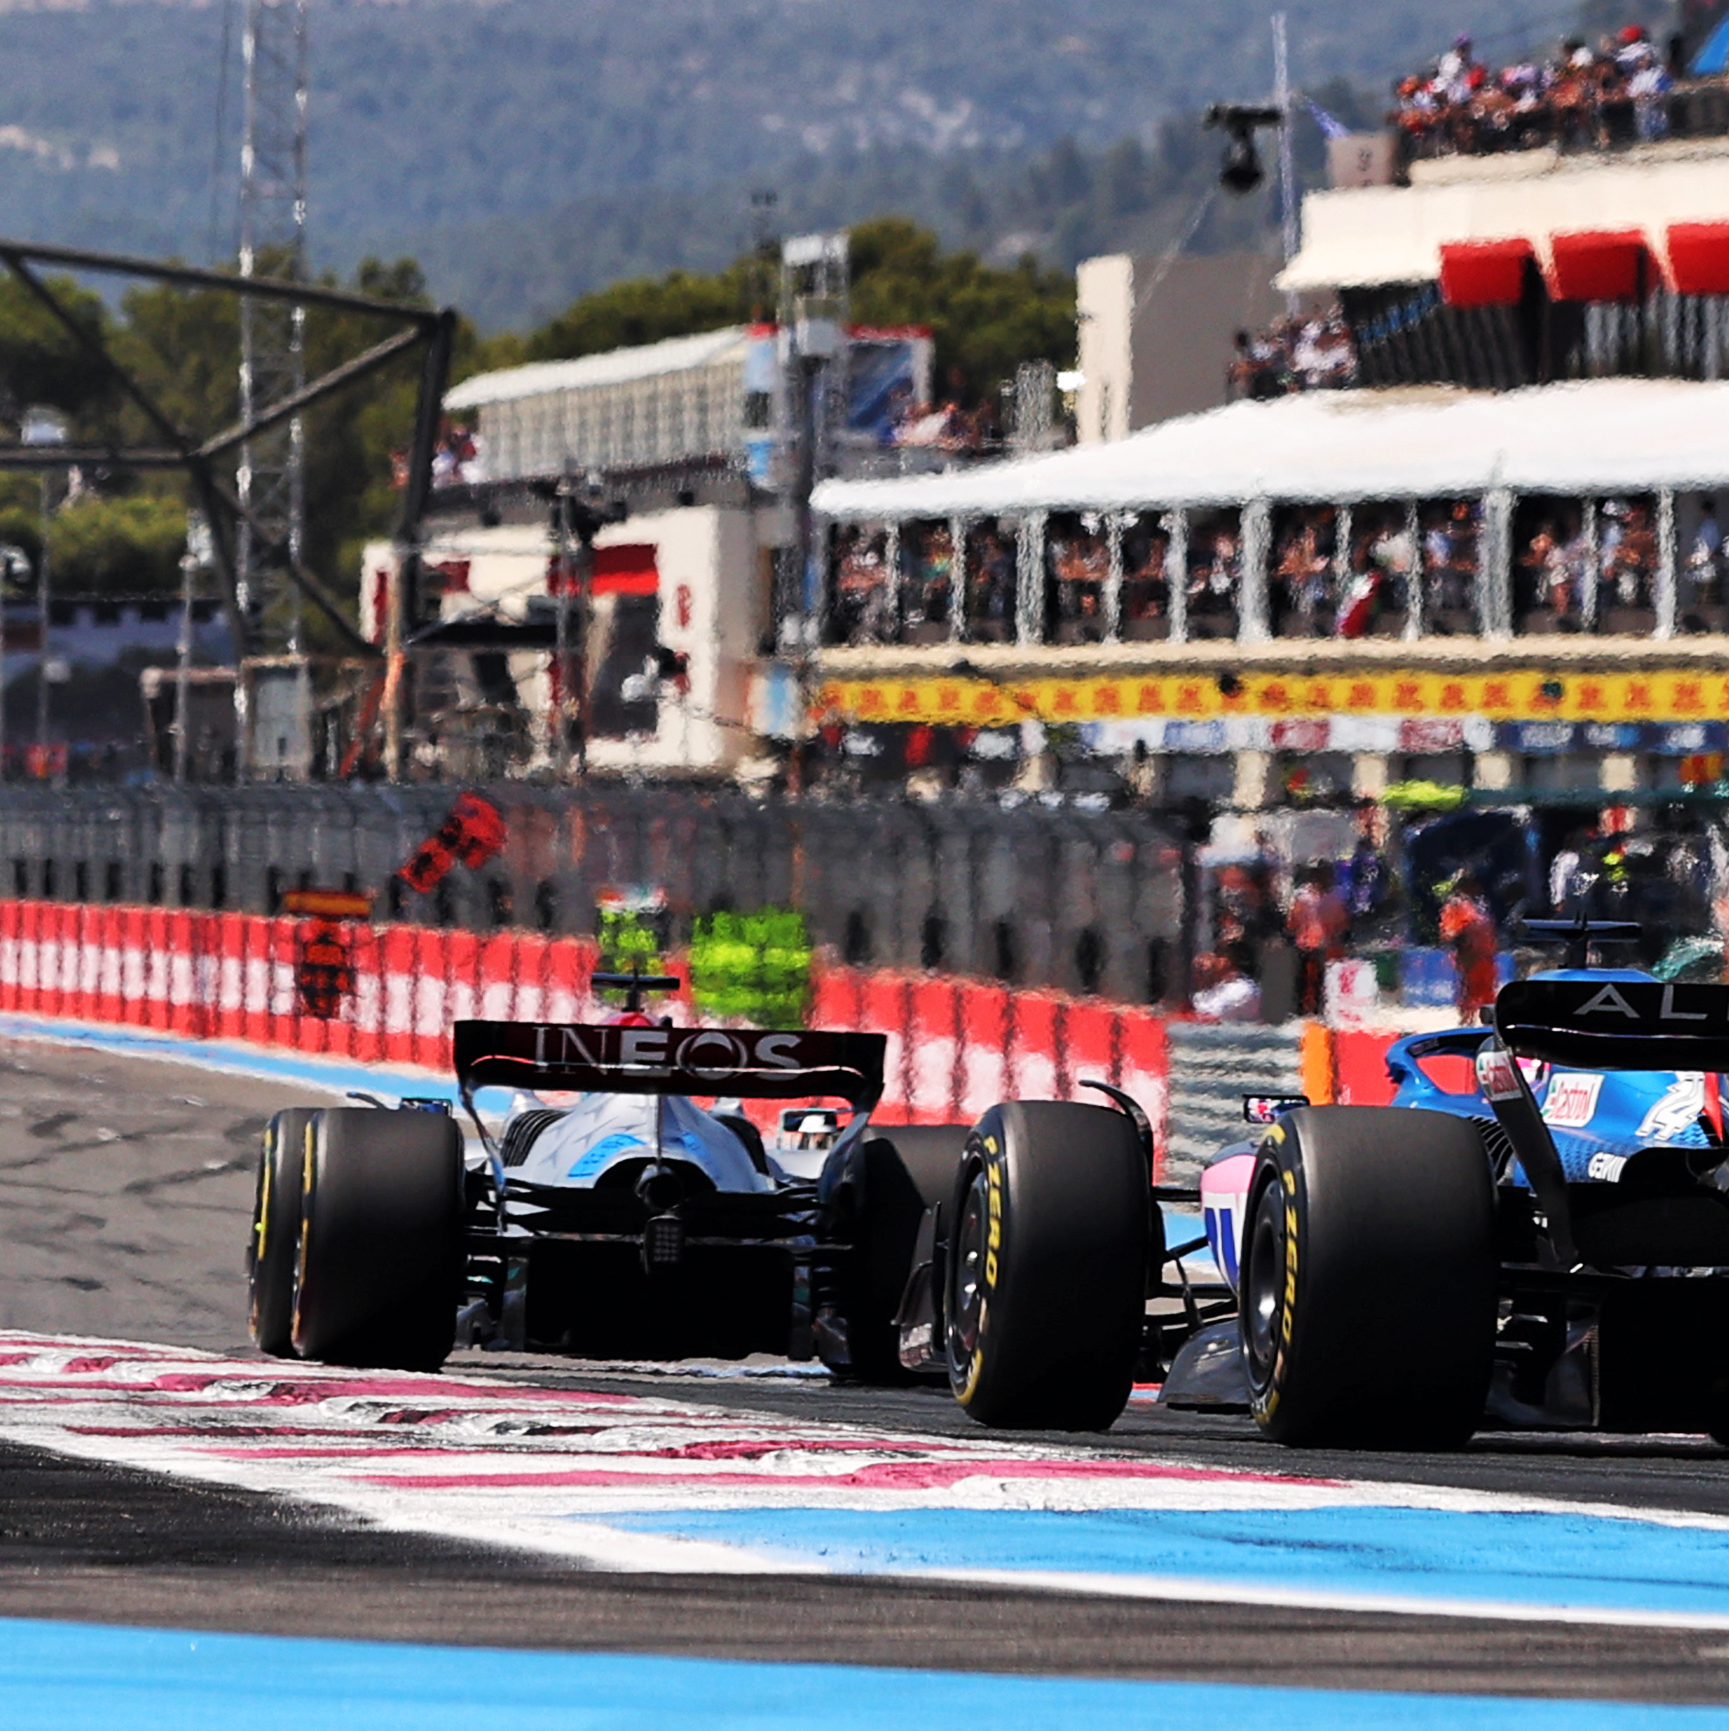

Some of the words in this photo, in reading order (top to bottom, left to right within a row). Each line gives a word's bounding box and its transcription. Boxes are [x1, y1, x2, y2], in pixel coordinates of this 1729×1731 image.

[531, 1027, 803, 1081] INEOS
[986, 1162, 1002, 1288] ZERO
[1282, 1205, 1299, 1345] ZERO
